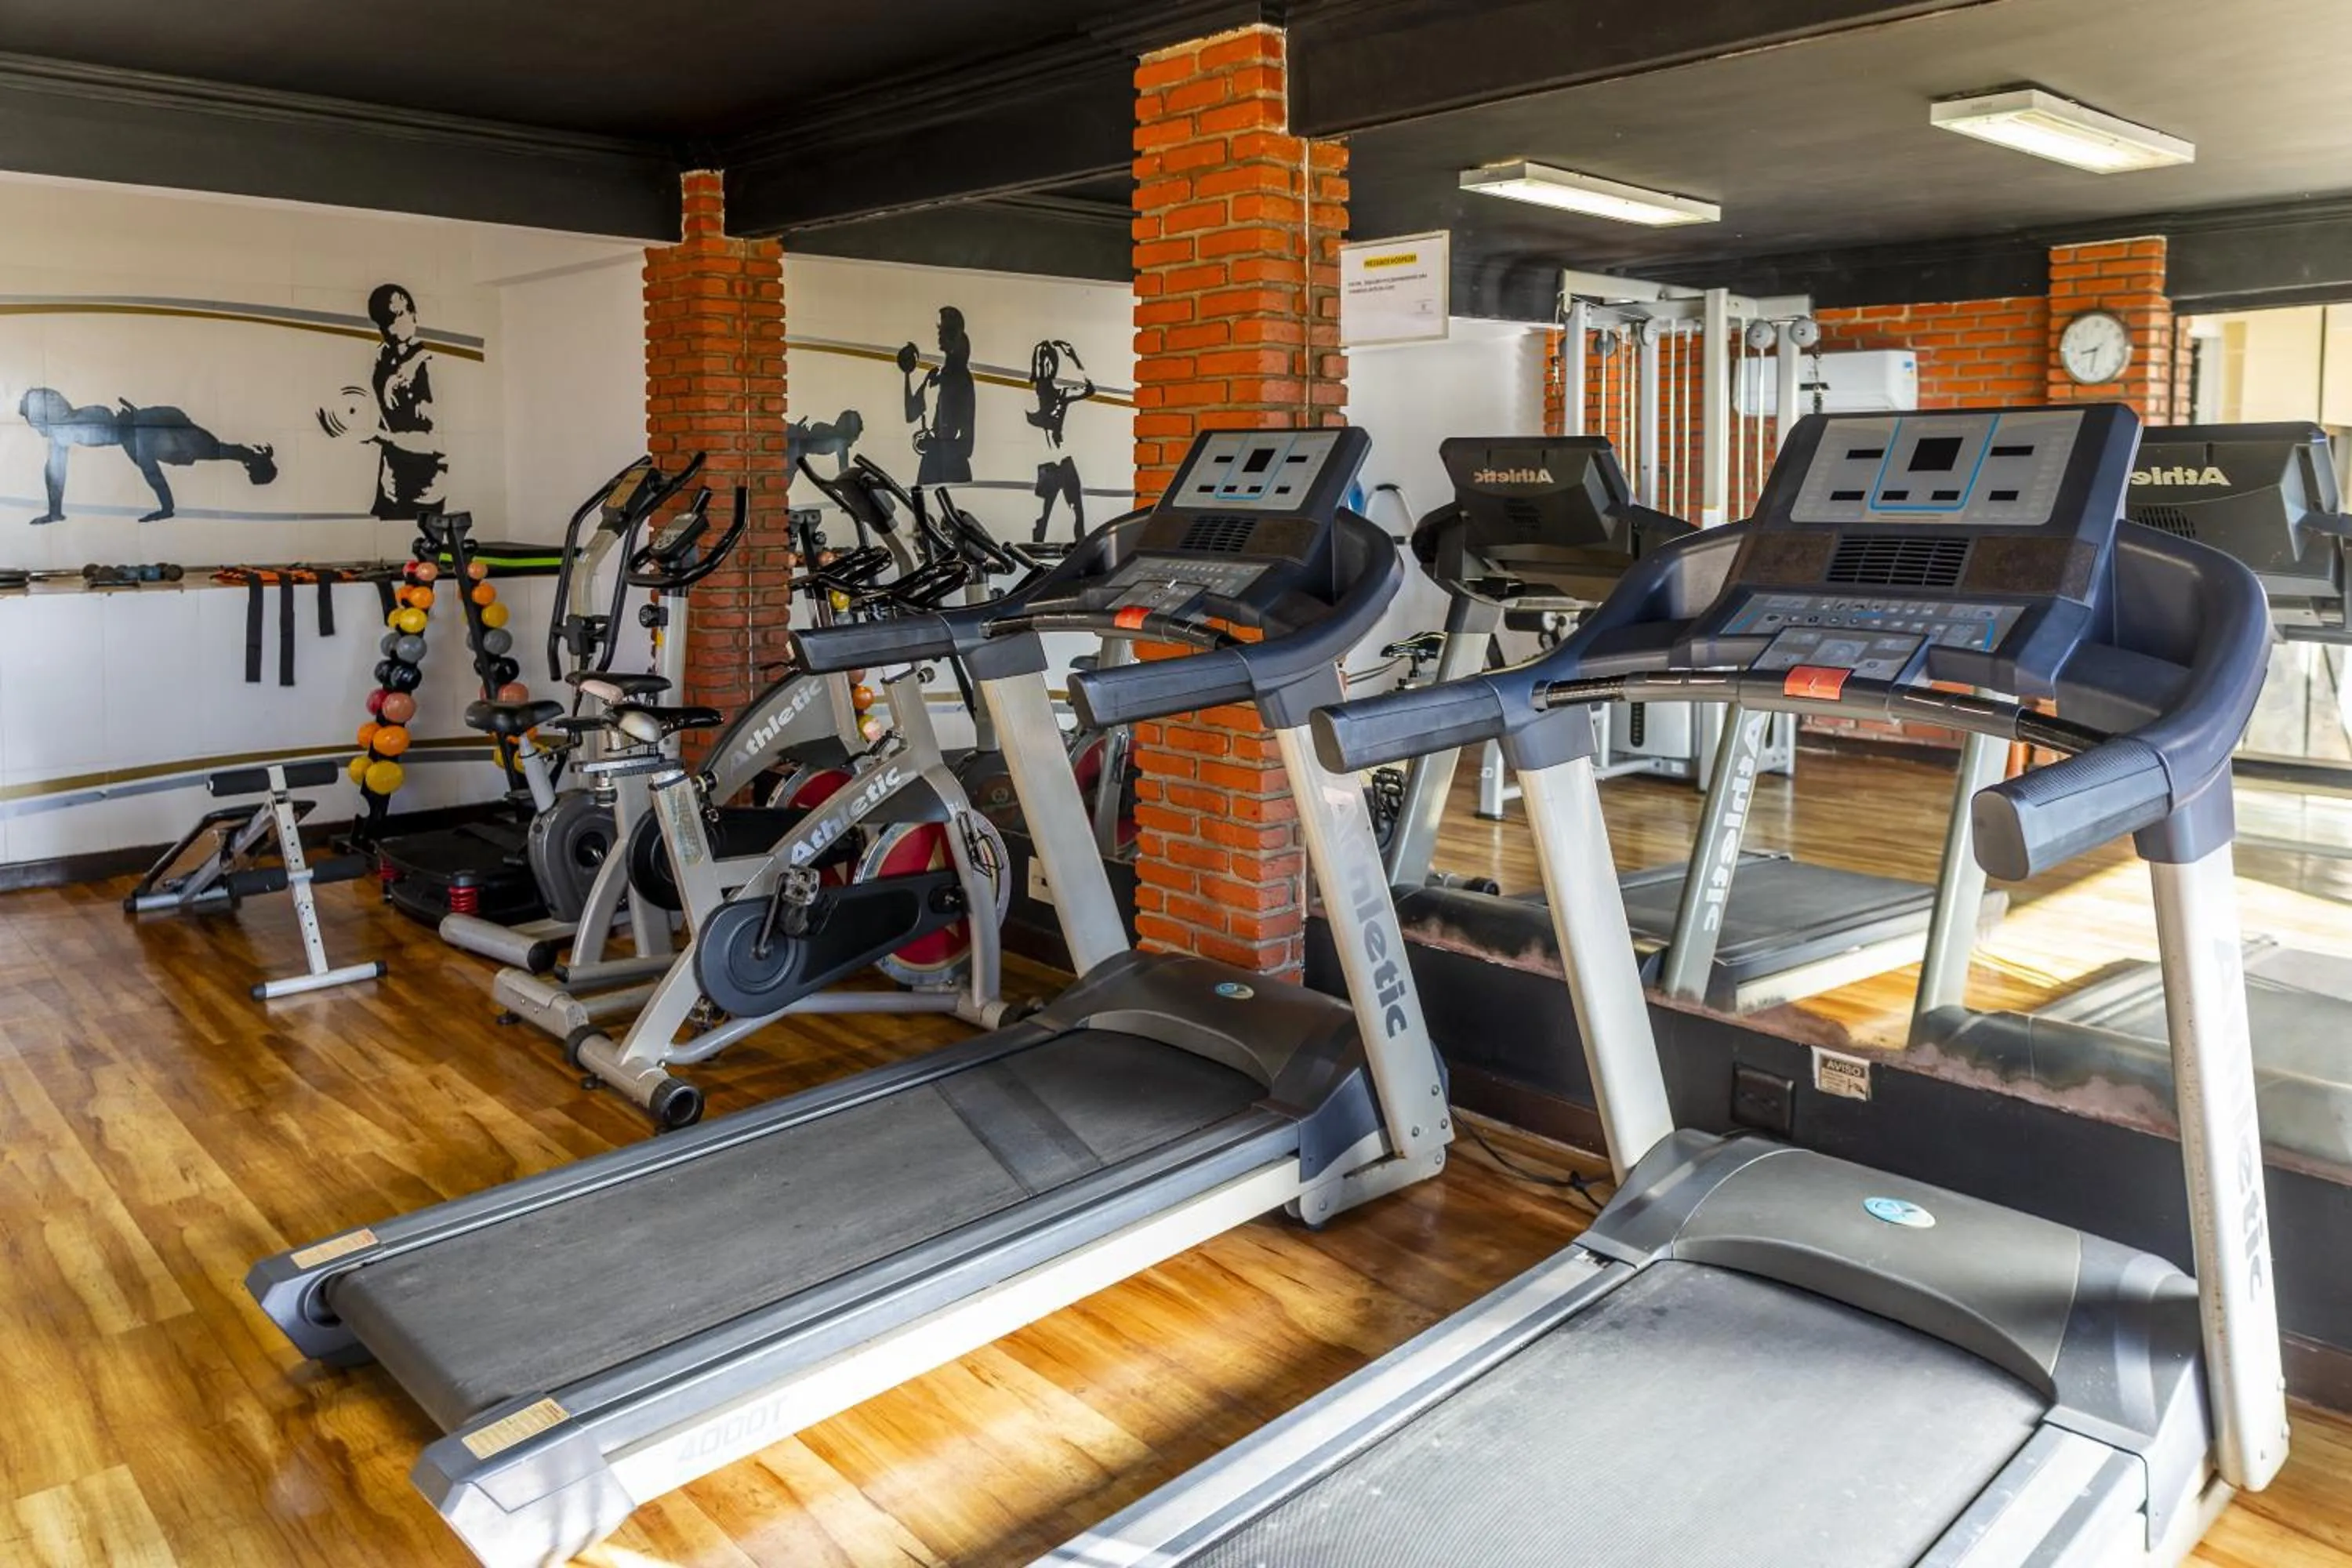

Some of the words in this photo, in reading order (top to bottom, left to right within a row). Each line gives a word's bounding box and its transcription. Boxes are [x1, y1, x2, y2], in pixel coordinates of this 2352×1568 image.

[729, 678, 823, 774] Athletic
[790, 767, 902, 865] Athletic
[1827, 1060, 1861, 1076] AVISO
[678, 1396, 788, 1461] 4000T
